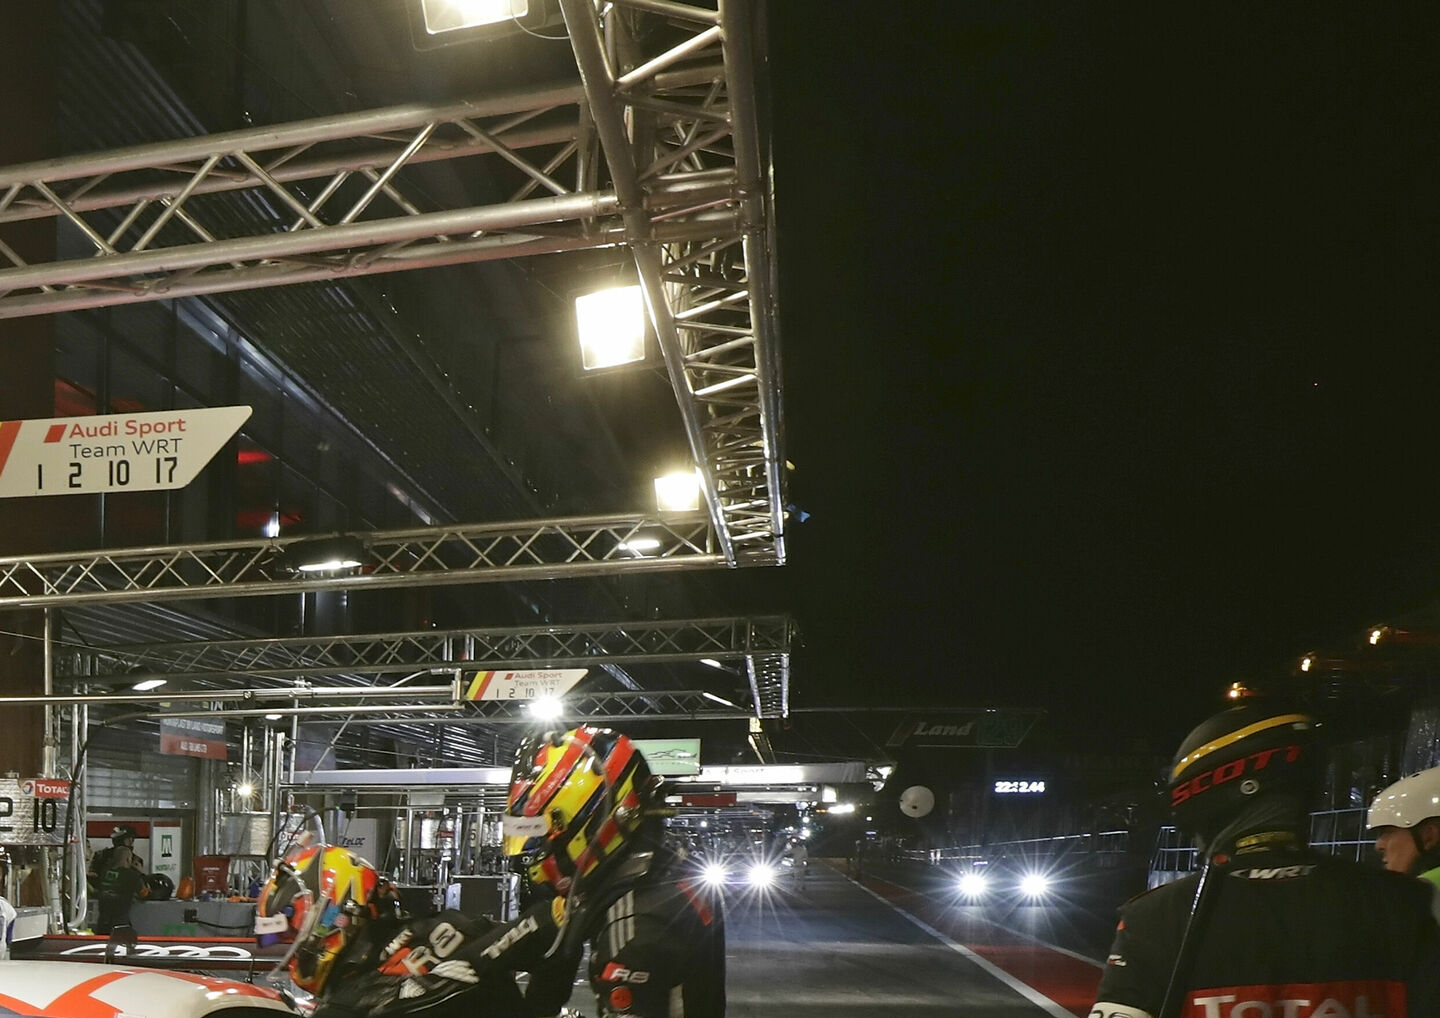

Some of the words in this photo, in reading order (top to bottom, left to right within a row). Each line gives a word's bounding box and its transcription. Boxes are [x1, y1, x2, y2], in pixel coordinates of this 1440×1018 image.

[68, 420, 119, 439] Audi
[125, 418, 187, 438] Sport
[69, 443, 126, 459] Team
[132, 438, 183, 455] WRT
[37, 463, 43, 490] 1
[68, 462, 82, 488] 2
[108, 460, 130, 486] 10
[156, 457, 178, 484] 17
[514, 671, 536, 680] Audi
[537, 671, 563, 680] Sport
[509, 688, 515, 698] 2
[913, 721, 976, 736] Land
[36, 784, 69, 794] TOTAL
[33, 798, 57, 833] 10
[1247, 864, 1318, 881] WRT
